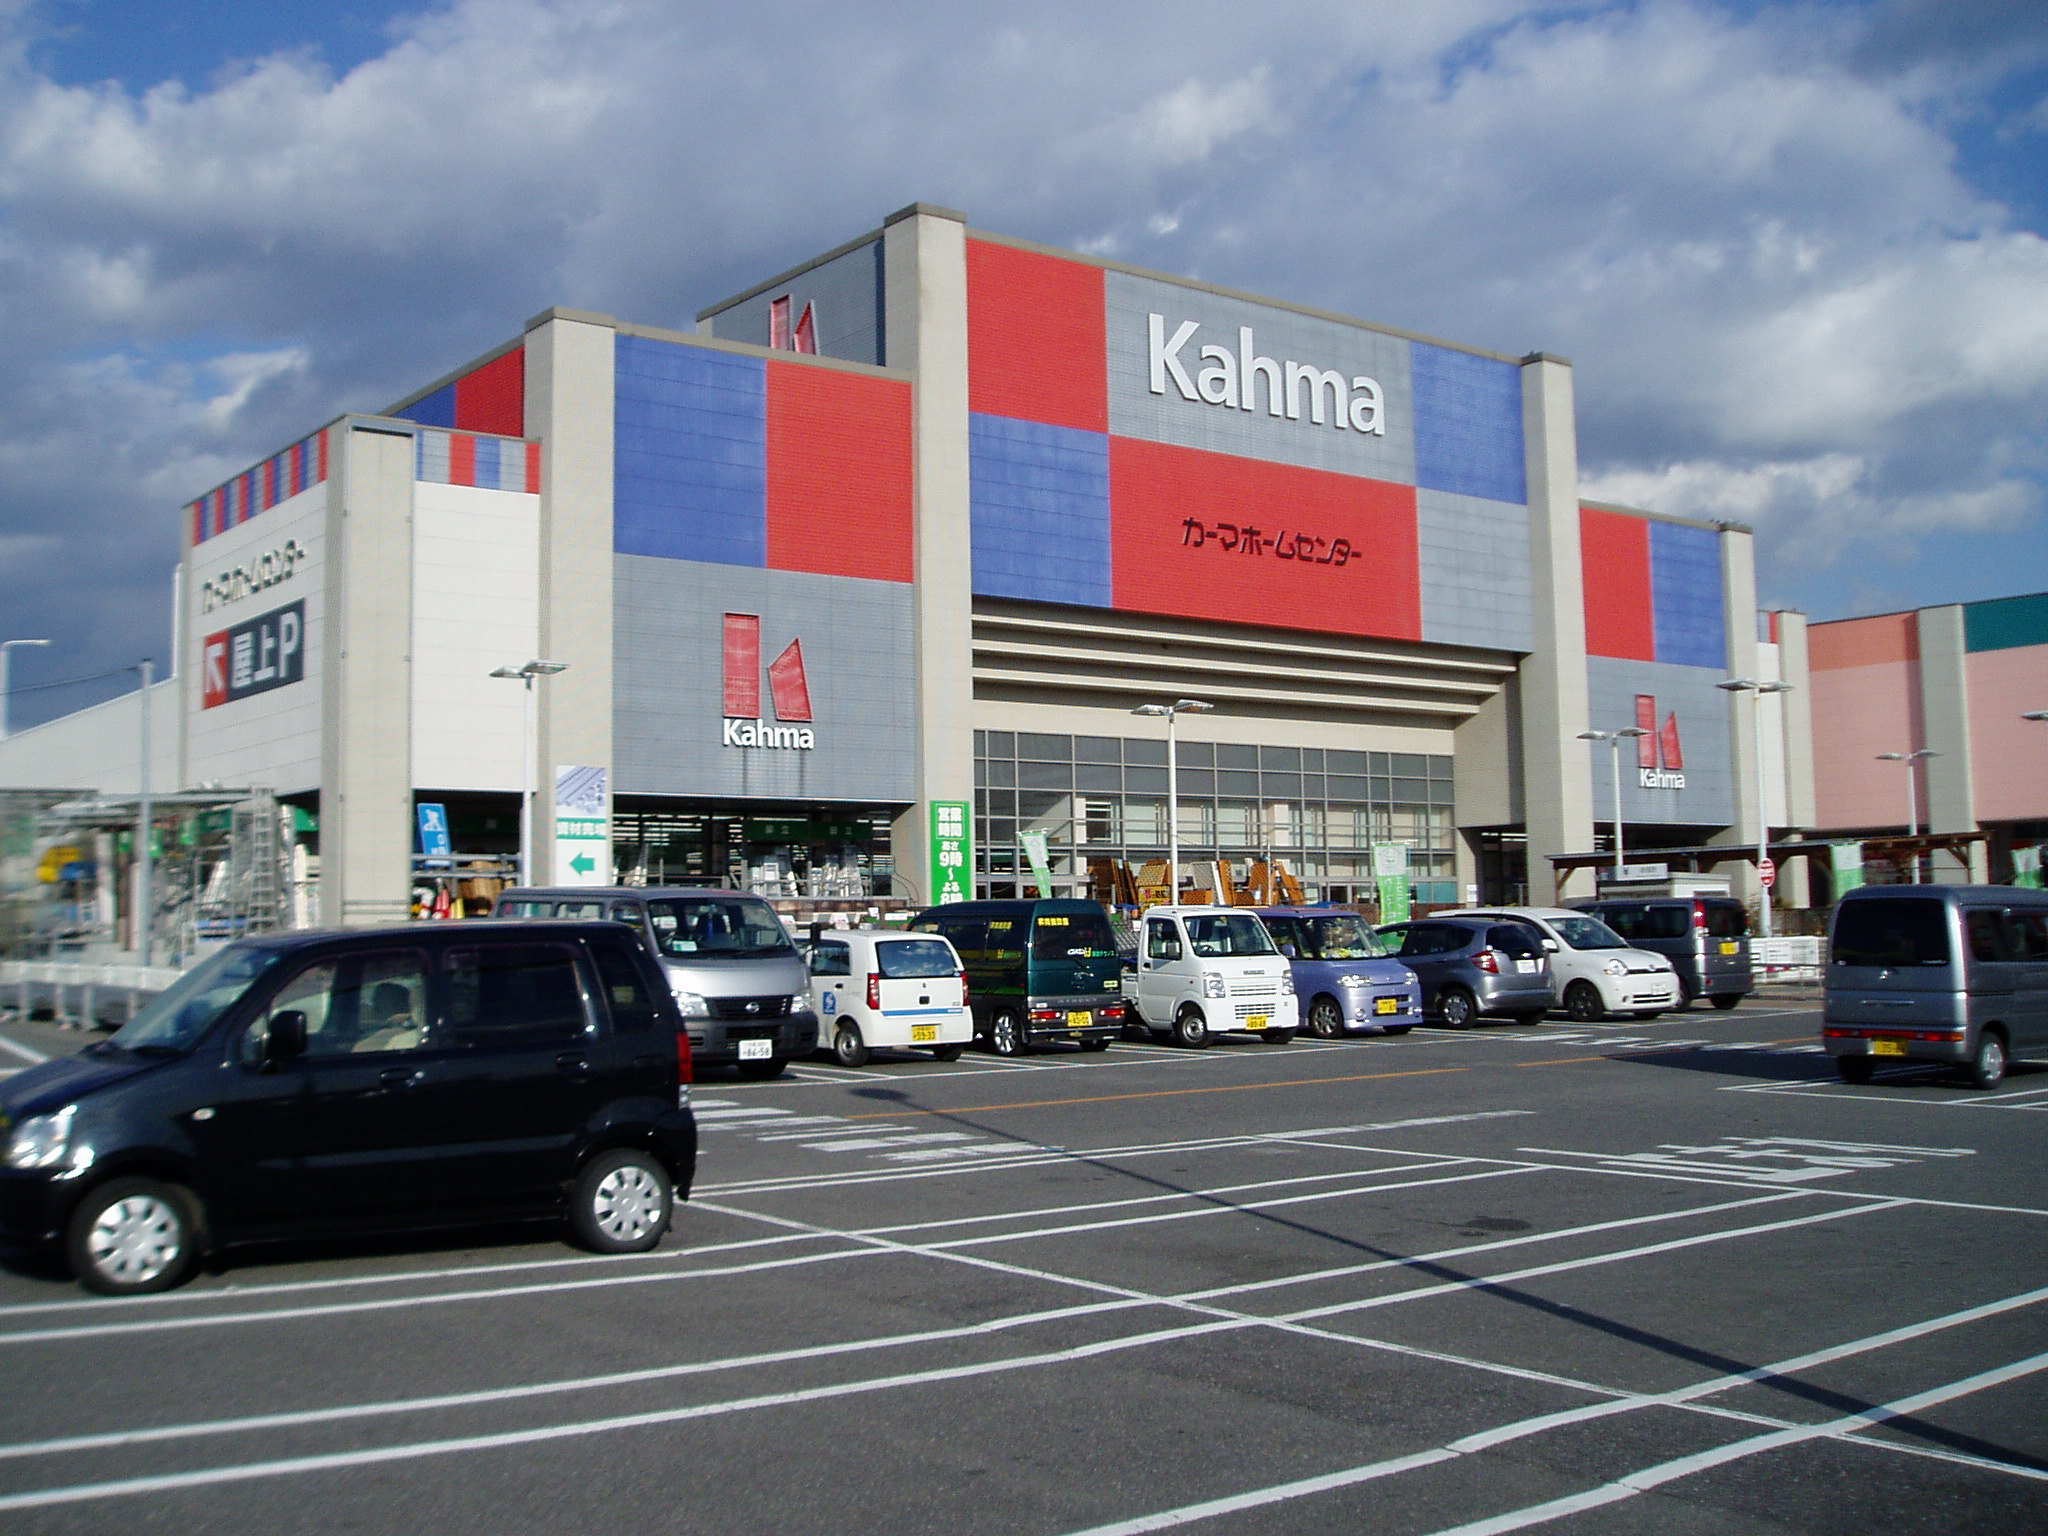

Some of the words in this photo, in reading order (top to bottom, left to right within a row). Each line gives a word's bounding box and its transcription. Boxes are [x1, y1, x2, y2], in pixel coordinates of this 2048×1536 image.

[1148, 313, 1386, 436] Kahma
[1182, 516, 1362, 566] カーマホームセンター
[231, 610, 300, 690] 屋上P
[723, 718, 815, 750] Kahma
[1639, 767, 1686, 789] Kahma
[938, 807, 962, 822] 営業
[938, 823, 962, 837] 時間
[939, 851, 963, 867] 9時
